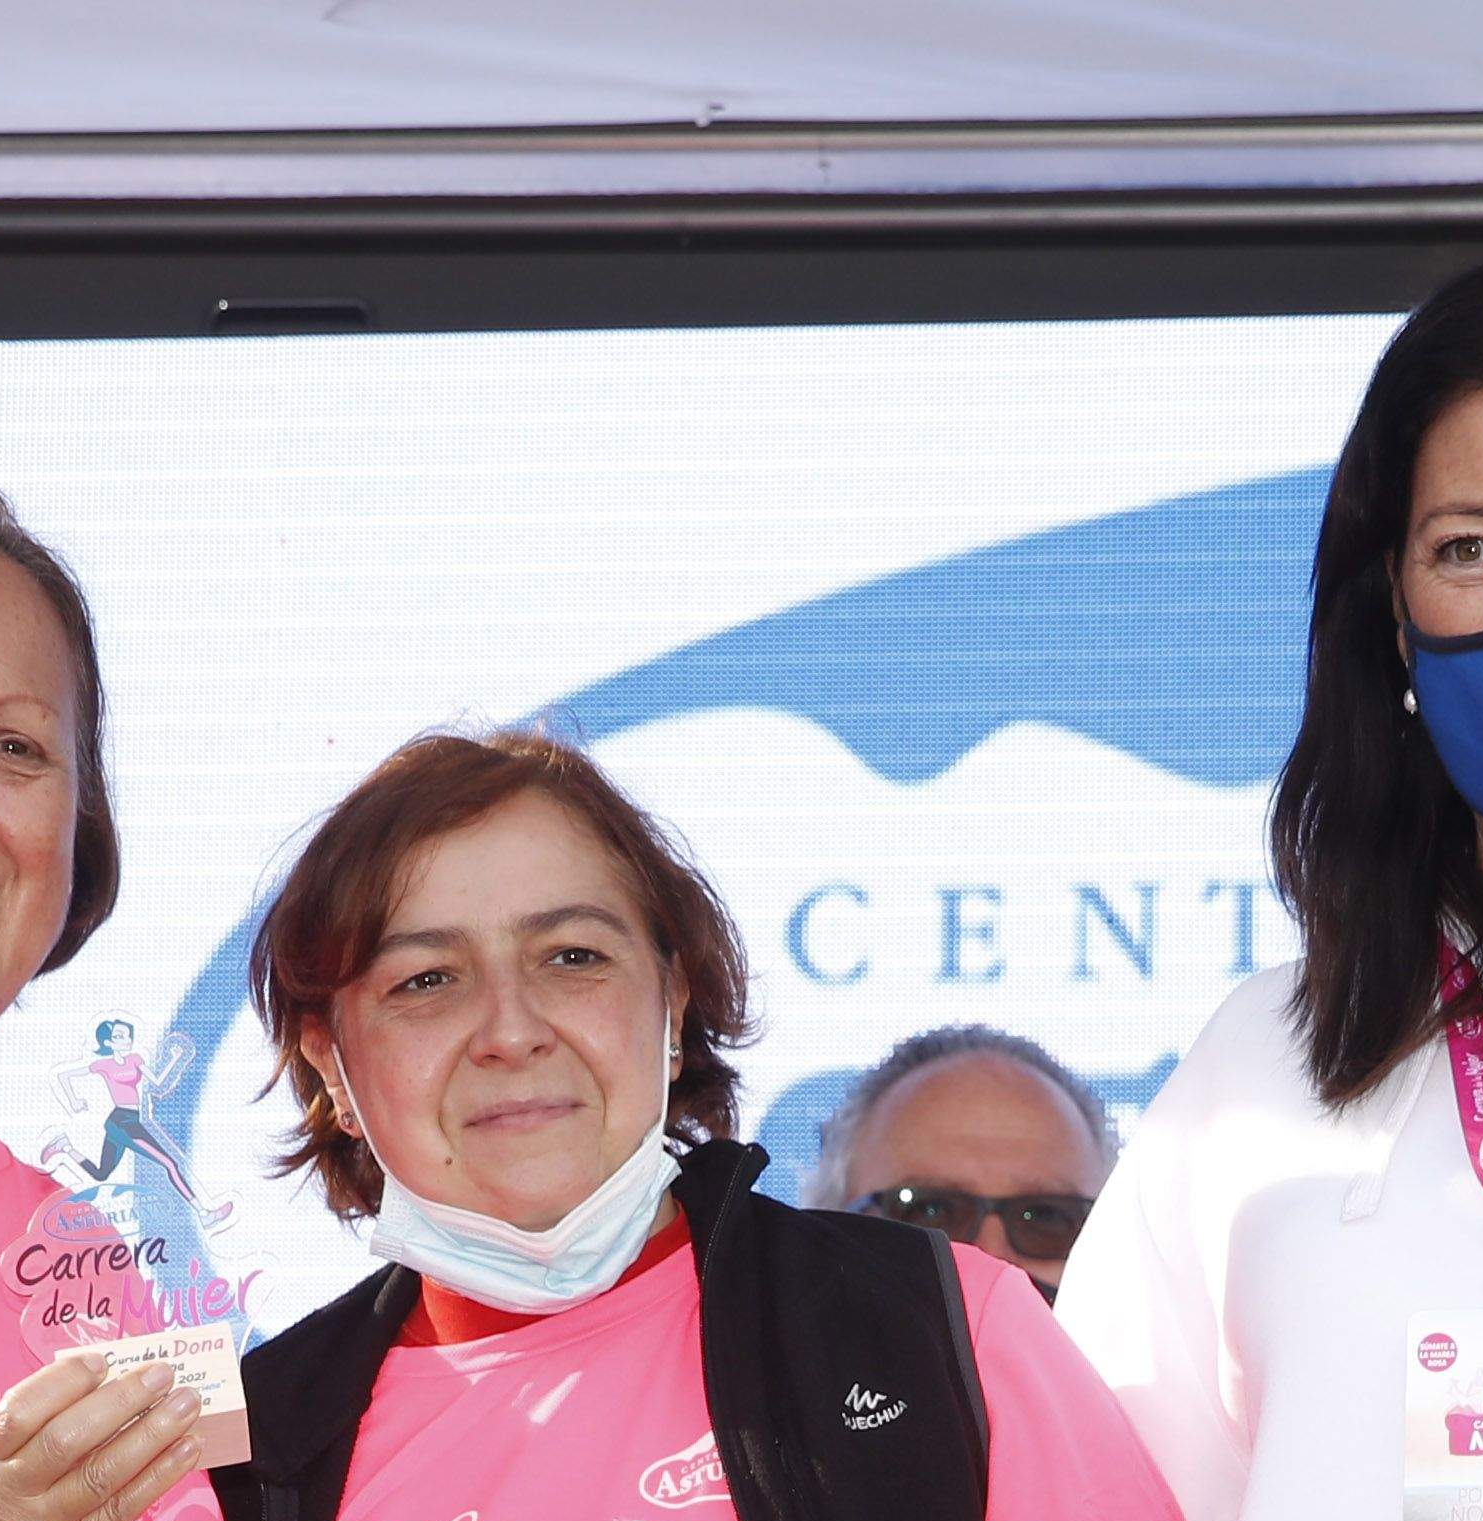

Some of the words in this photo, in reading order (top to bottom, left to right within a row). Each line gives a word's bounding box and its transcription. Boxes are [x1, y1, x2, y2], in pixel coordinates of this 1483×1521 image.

[783, 879, 1288, 986] CENT
[16, 1237, 169, 1286] Carrera
[42, 1290, 77, 1327] de
[87, 1282, 113, 1313] la
[118, 1259, 264, 1339] Mujer
[142, 1348, 155, 1362] de
[173, 1338, 224, 1357] Dona
[179, 1371, 207, 1384] 2021
[681, 1451, 719, 1474] CENTR
